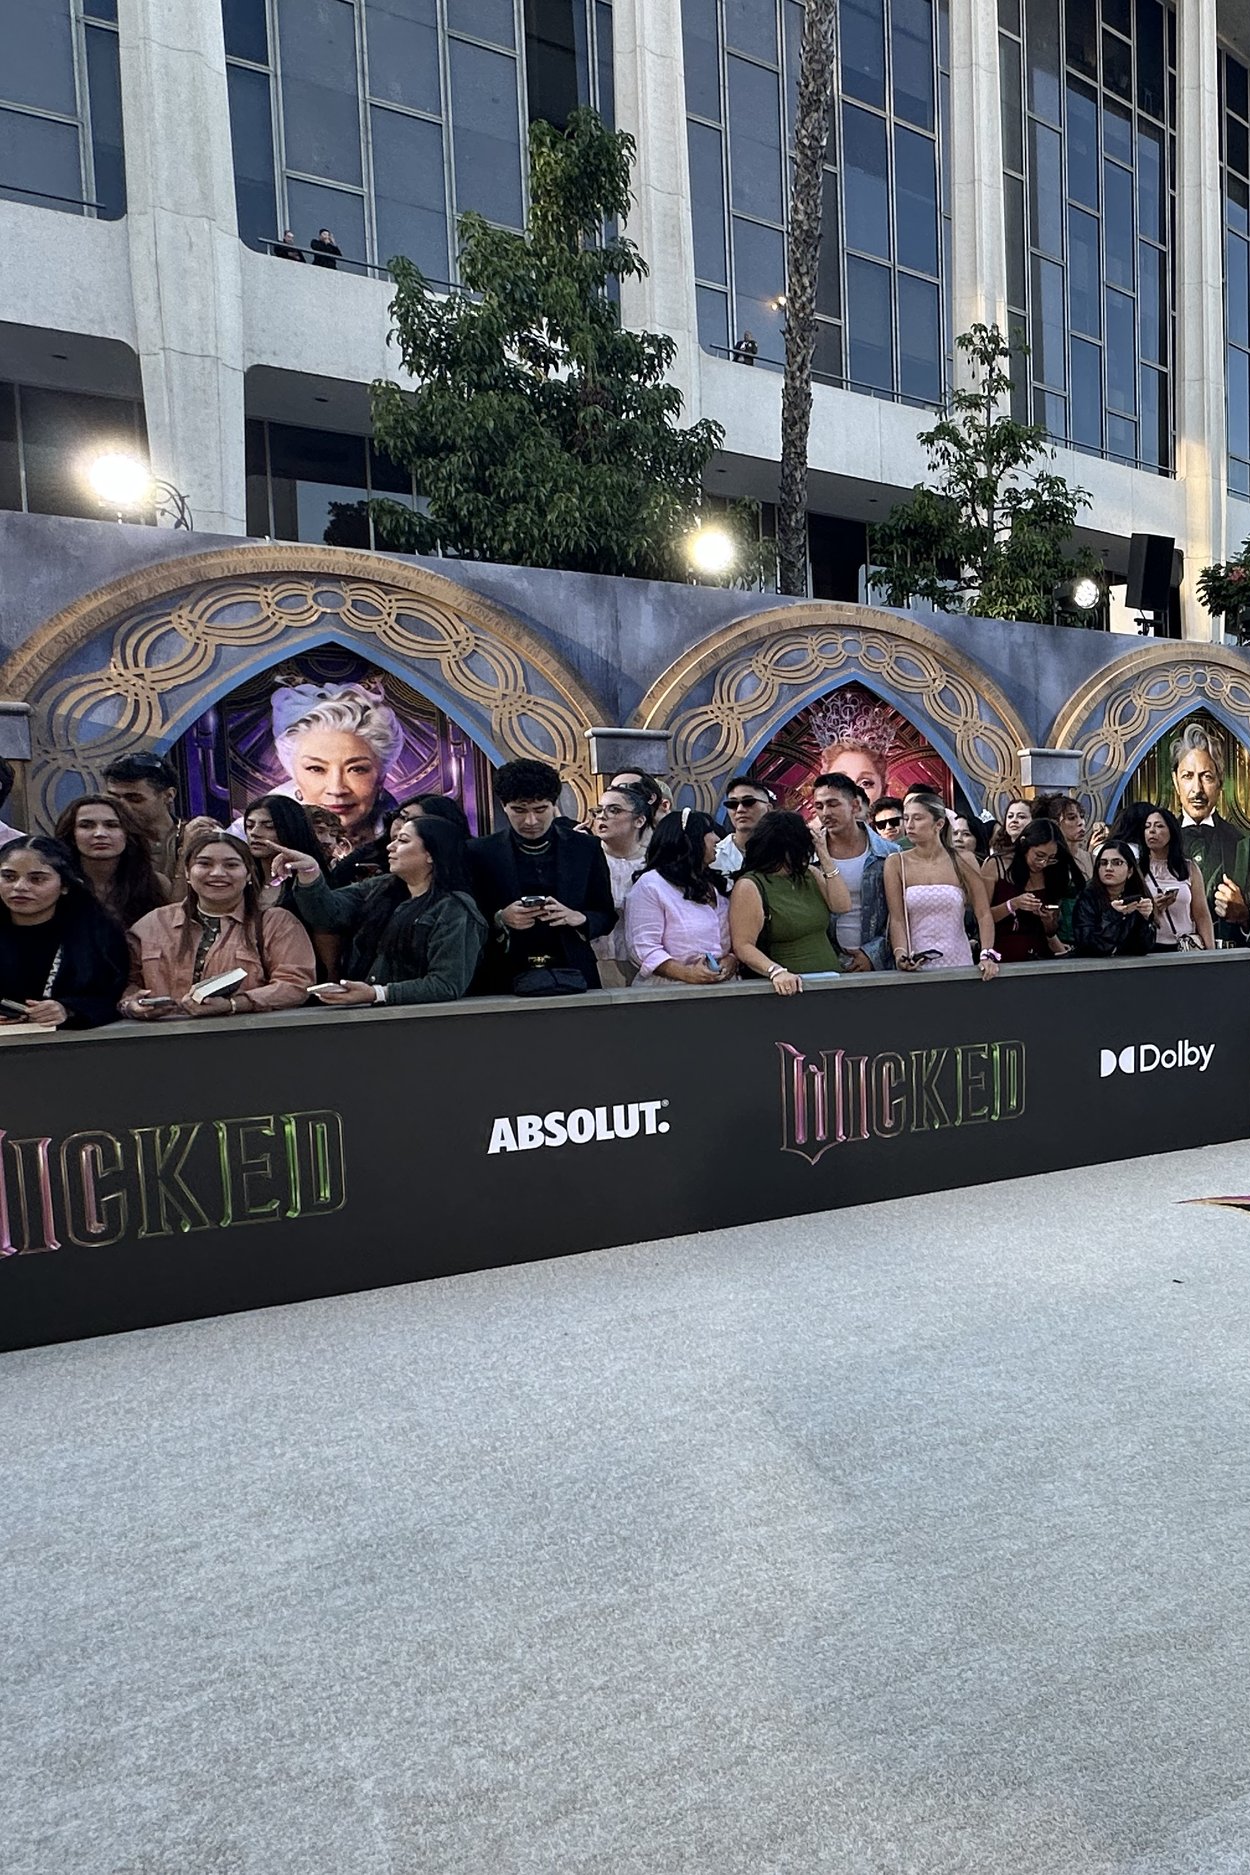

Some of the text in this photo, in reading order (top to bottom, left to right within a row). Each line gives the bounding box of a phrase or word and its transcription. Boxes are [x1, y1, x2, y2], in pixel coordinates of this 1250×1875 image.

[775, 1041, 1026, 1166] WICKED
[1139, 1039, 1216, 1072] Dolby
[0, 1109, 348, 1260] ICKED
